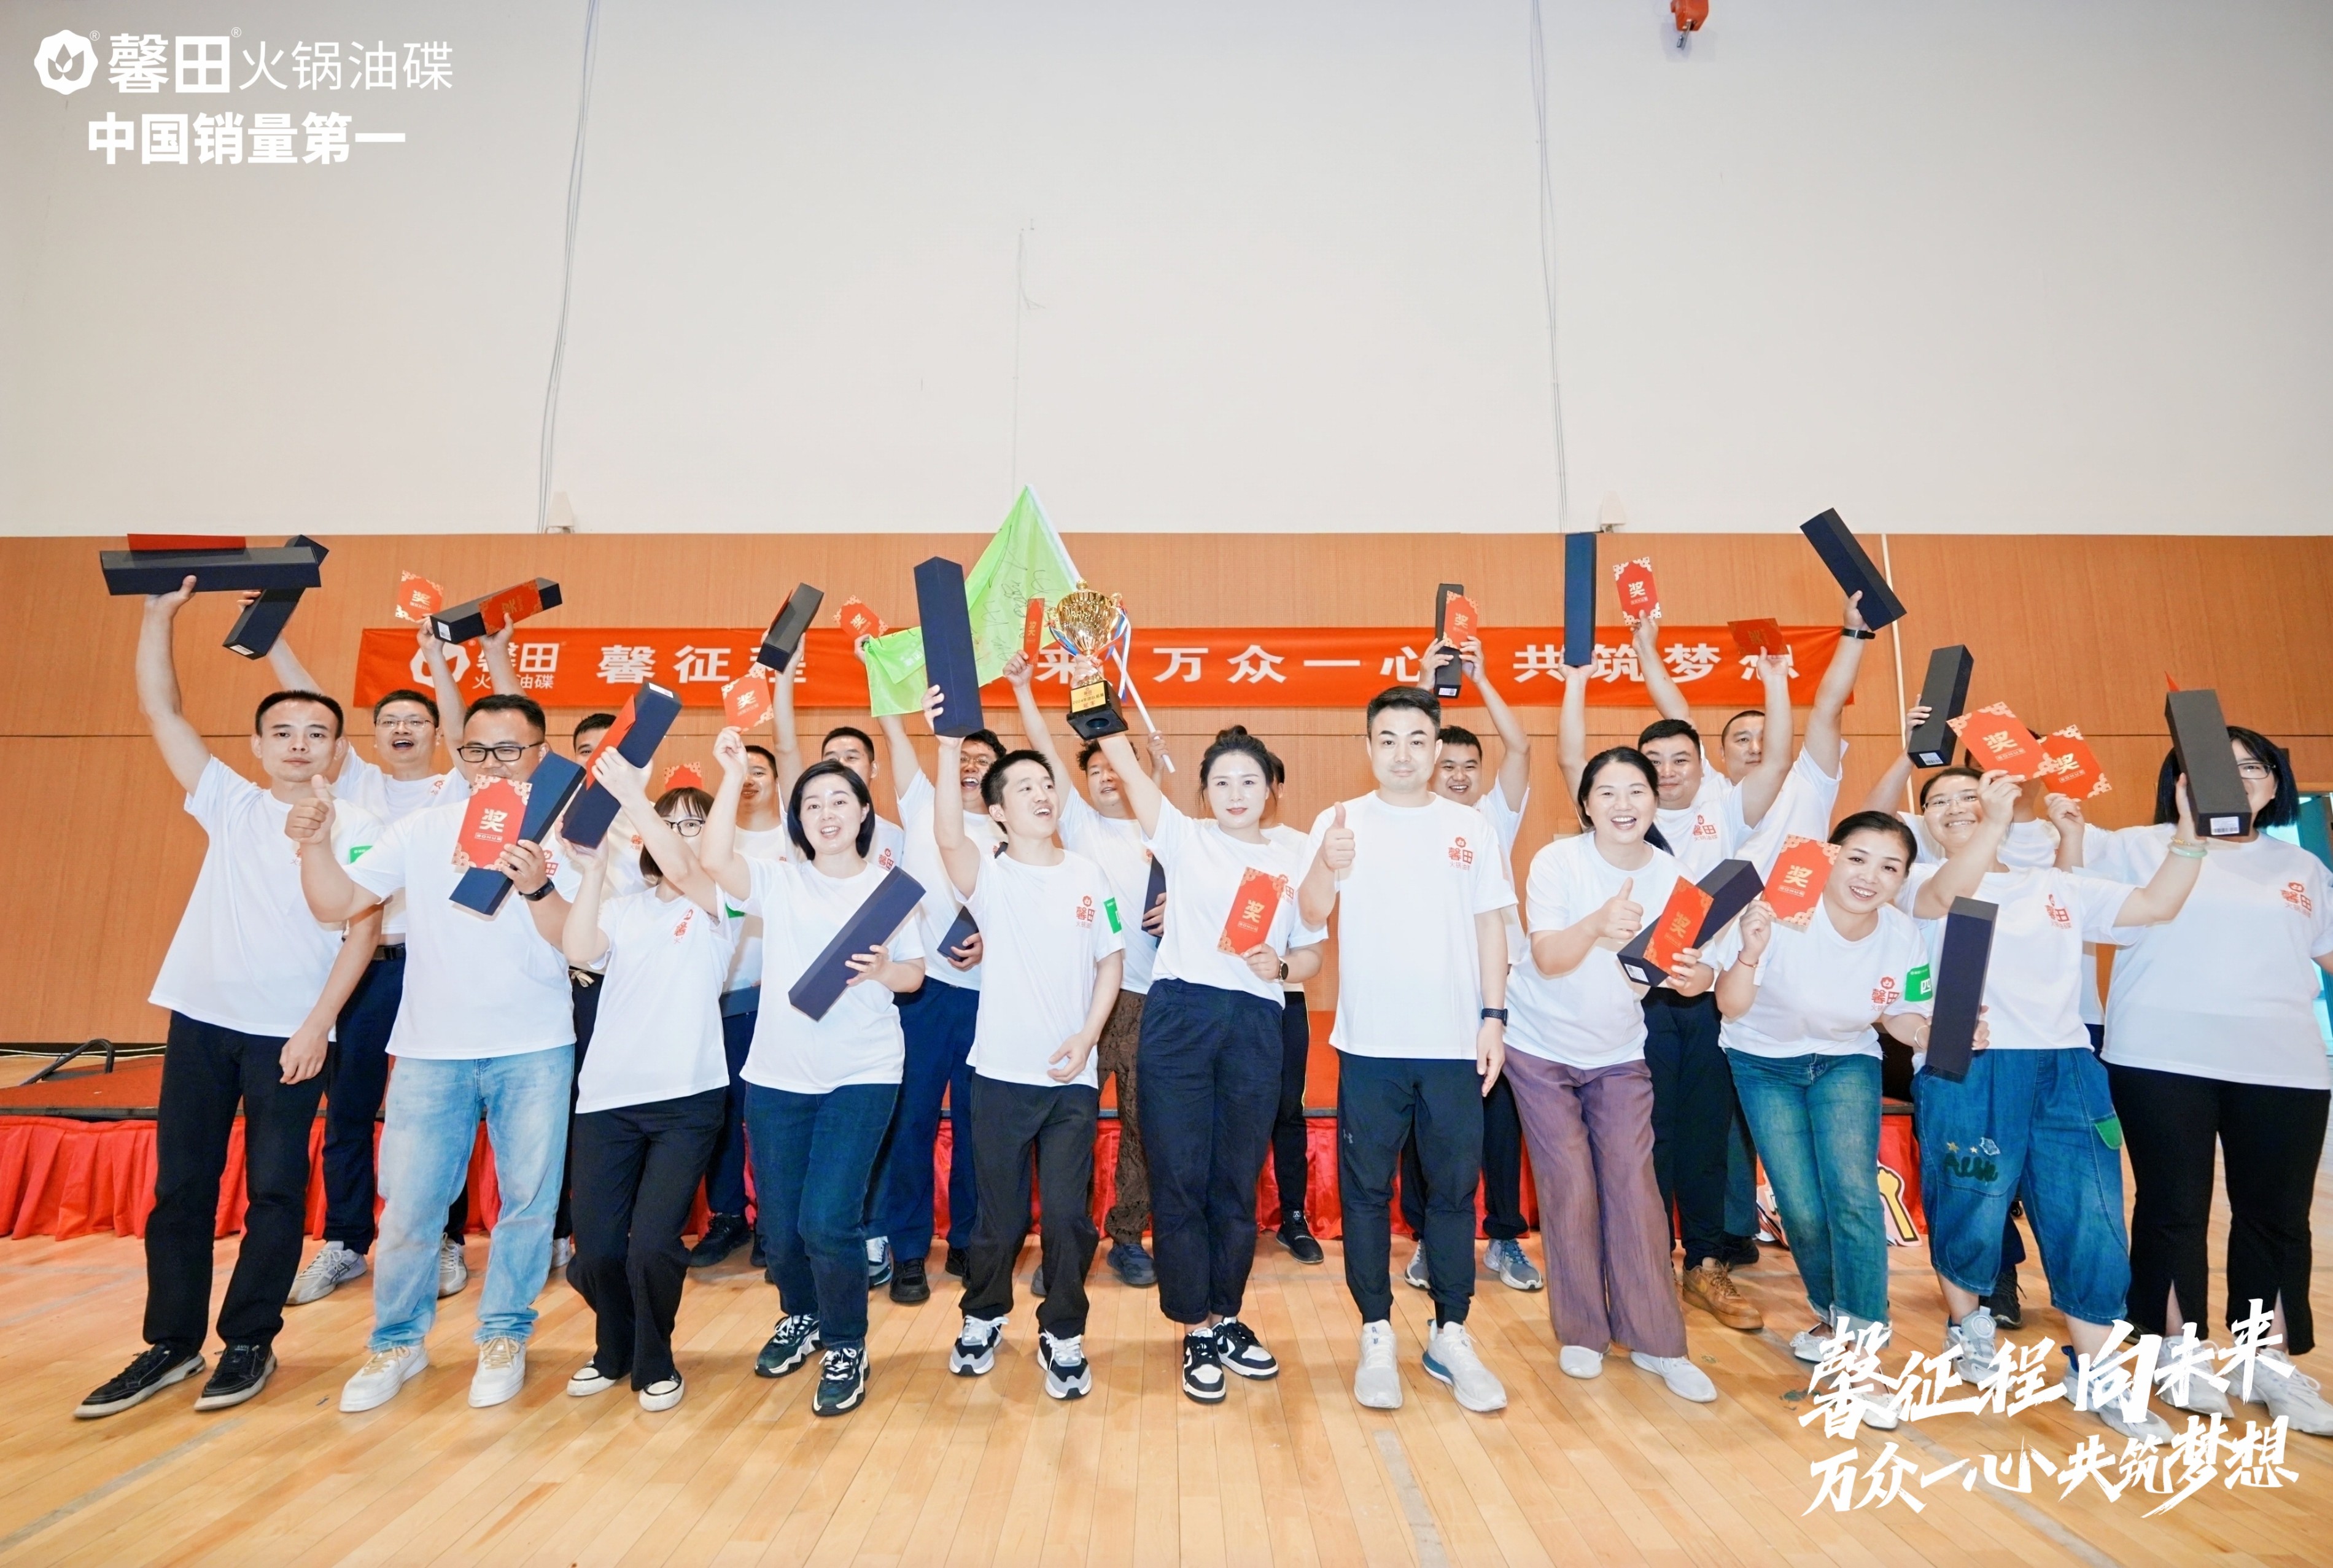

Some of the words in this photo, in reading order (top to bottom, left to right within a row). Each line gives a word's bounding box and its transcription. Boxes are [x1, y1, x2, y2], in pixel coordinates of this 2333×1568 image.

[411, 589, 431, 607] 奖
[1628, 581, 1646, 598] 奖
[850, 613, 868, 631] 奖
[1454, 613, 1469, 629] 奖
[1152, 644, 1421, 684] 万众一心
[472, 673, 554, 689] 火油碟
[737, 690, 756, 710] 奖
[1982, 731, 2019, 753] 奖
[2054, 753, 2080, 775] 奖
[478, 808, 508, 833] 奖
[1448, 847, 1473, 864] 馨田
[1784, 864, 1812, 888] 奖
[1076, 906, 1095, 922] 馨田
[1241, 899, 1265, 923] 奖
[1669, 911, 1691, 939] 奖
